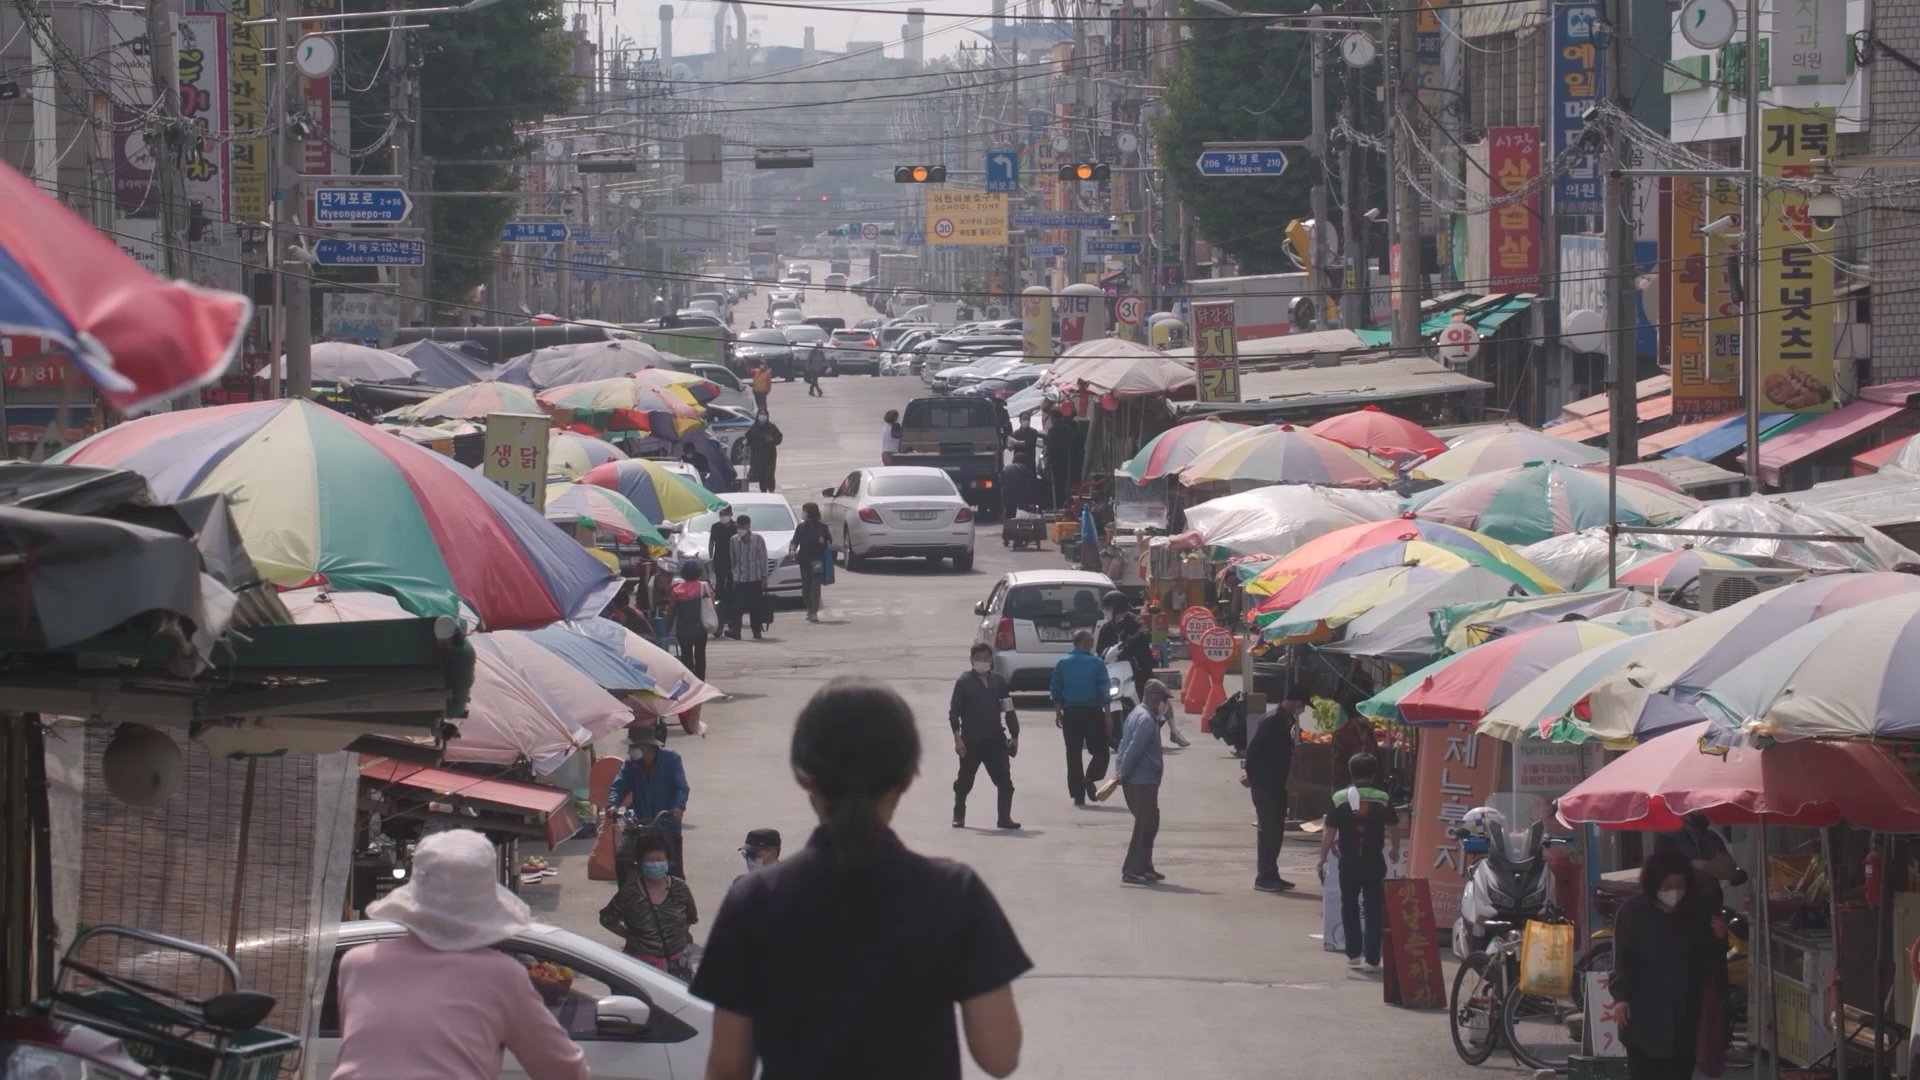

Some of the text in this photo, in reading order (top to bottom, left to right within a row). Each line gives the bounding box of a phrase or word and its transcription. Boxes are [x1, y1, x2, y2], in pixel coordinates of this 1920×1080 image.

[1416, 37, 1440, 53] 3-987
[1791, 52, 1822, 69] 의원
[1562, 43, 1596, 97] 예일
[1496, 132, 1535, 154] 시장
[1766, 123, 1829, 156] 거북
[1226, 154, 1260, 165] 가정로
[1266, 158, 1281, 167] 210
[989, 181, 1017, 191] 비보호
[1565, 183, 1596, 198] 의원
[320, 192, 374, 207] 면개포로
[935, 202, 1000, 211] SCHOOL ZONE
[320, 209, 392, 220] Myeongaepo-ro
[1498, 157, 1531, 269] 삼겹살
[502, 229, 511, 237] 01
[517, 224, 545, 234] 가정로
[551, 229, 565, 237] 205
[939, 224, 951, 233] 30
[336, 255, 375, 264] Geobuk-ro
[1779, 247, 1813, 360] 도넛츠
[1197, 306, 1233, 323] 닭강정
[1447, 328, 1473, 353] 약
[1714, 333, 1741, 357] 전문
[1680, 312, 1705, 386] 족발
[1198, 327, 1238, 402] 치킨
[1676, 399, 1736, 413] 573-2821
[491, 444, 540, 470] 생닭
[1205, 637, 1231, 647] 주차금지
[1433, 726, 1477, 876] 제누룽지
